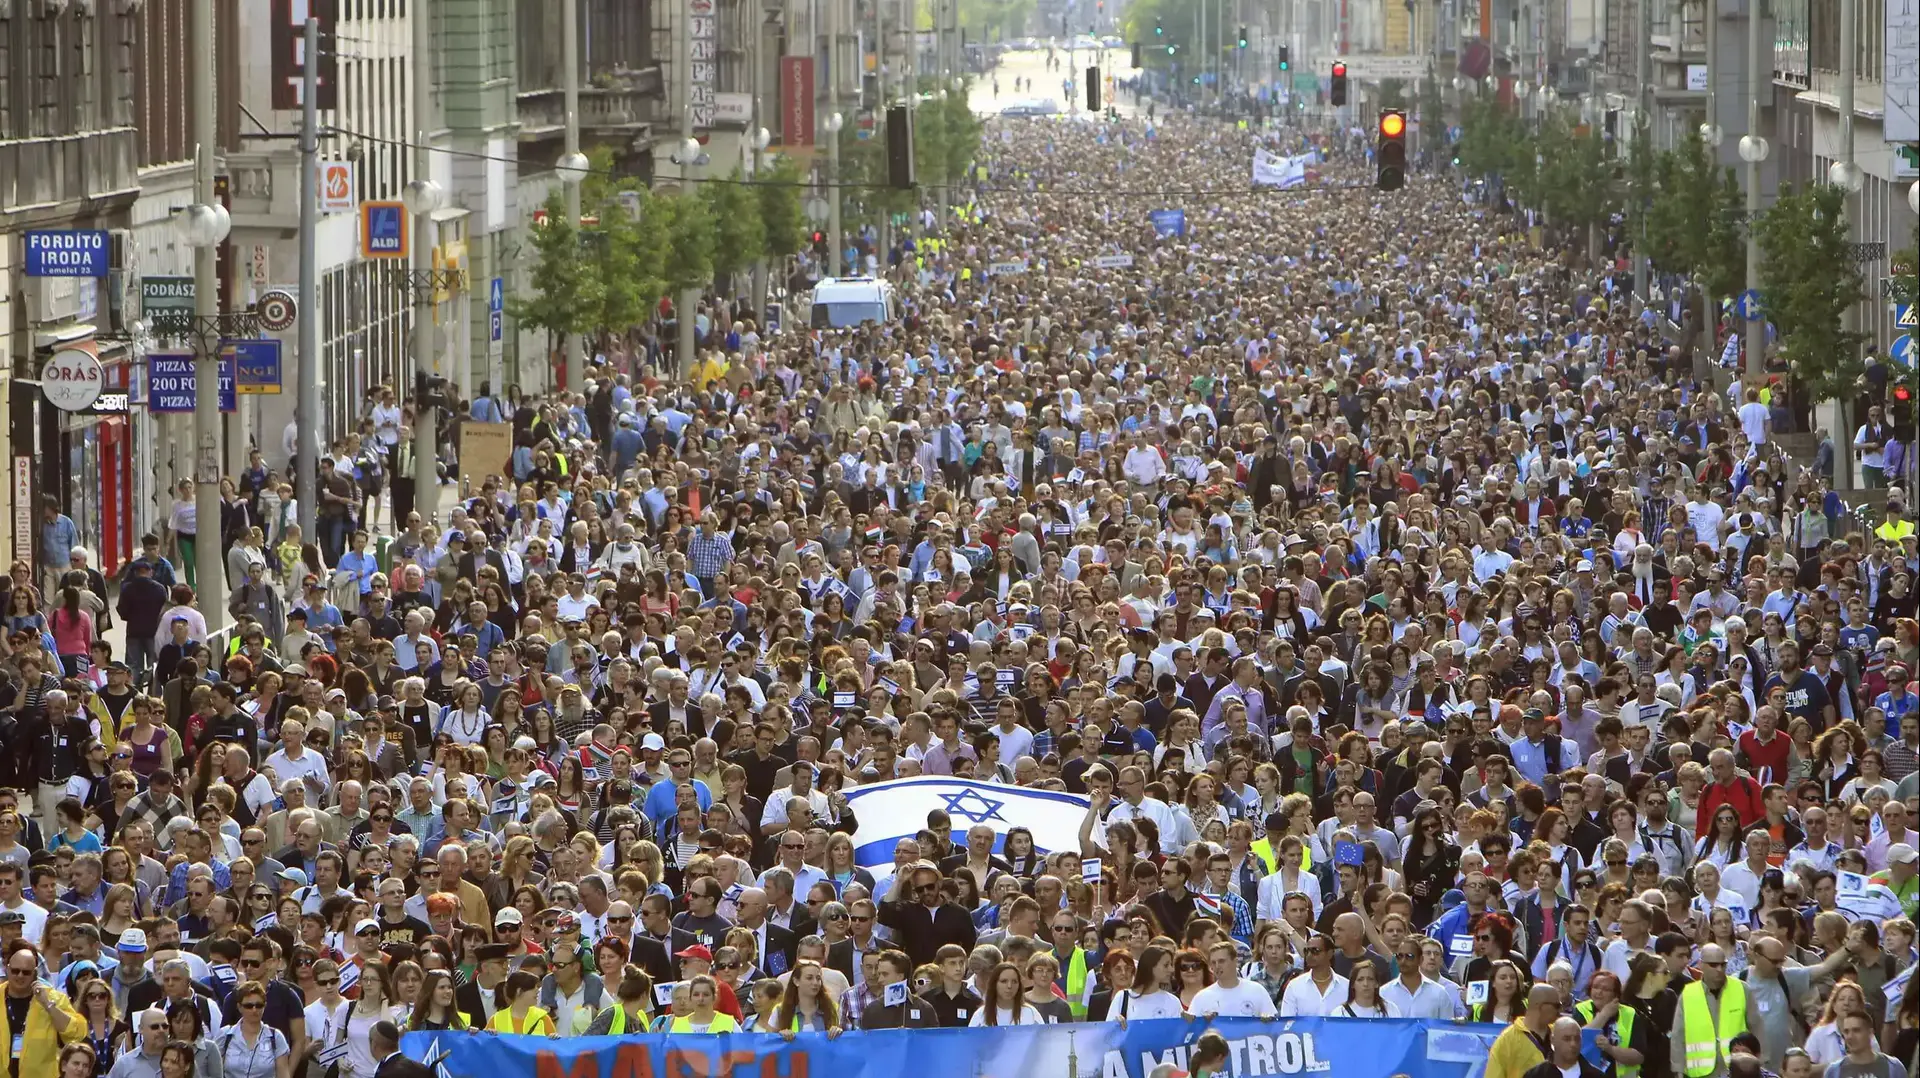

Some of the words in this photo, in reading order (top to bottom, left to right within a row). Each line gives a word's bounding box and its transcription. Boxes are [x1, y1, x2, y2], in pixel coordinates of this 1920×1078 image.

[692, 19, 704, 125] JAPAN
[30, 233, 102, 249] FORDÍTÓ
[371, 238, 399, 249] ALDI
[41, 252, 92, 265] IRODA
[49, 267, 78, 275] emelet
[143, 280, 196, 297] FODRÁSZ
[493, 317, 500, 337] P
[47, 360, 98, 381] ÓRÁS
[155, 360, 187, 373] PIZZA
[152, 377, 178, 391] 200
[160, 396, 192, 407] PIZZA
[1141, 1021, 1331, 1078] MÚTRÓL
